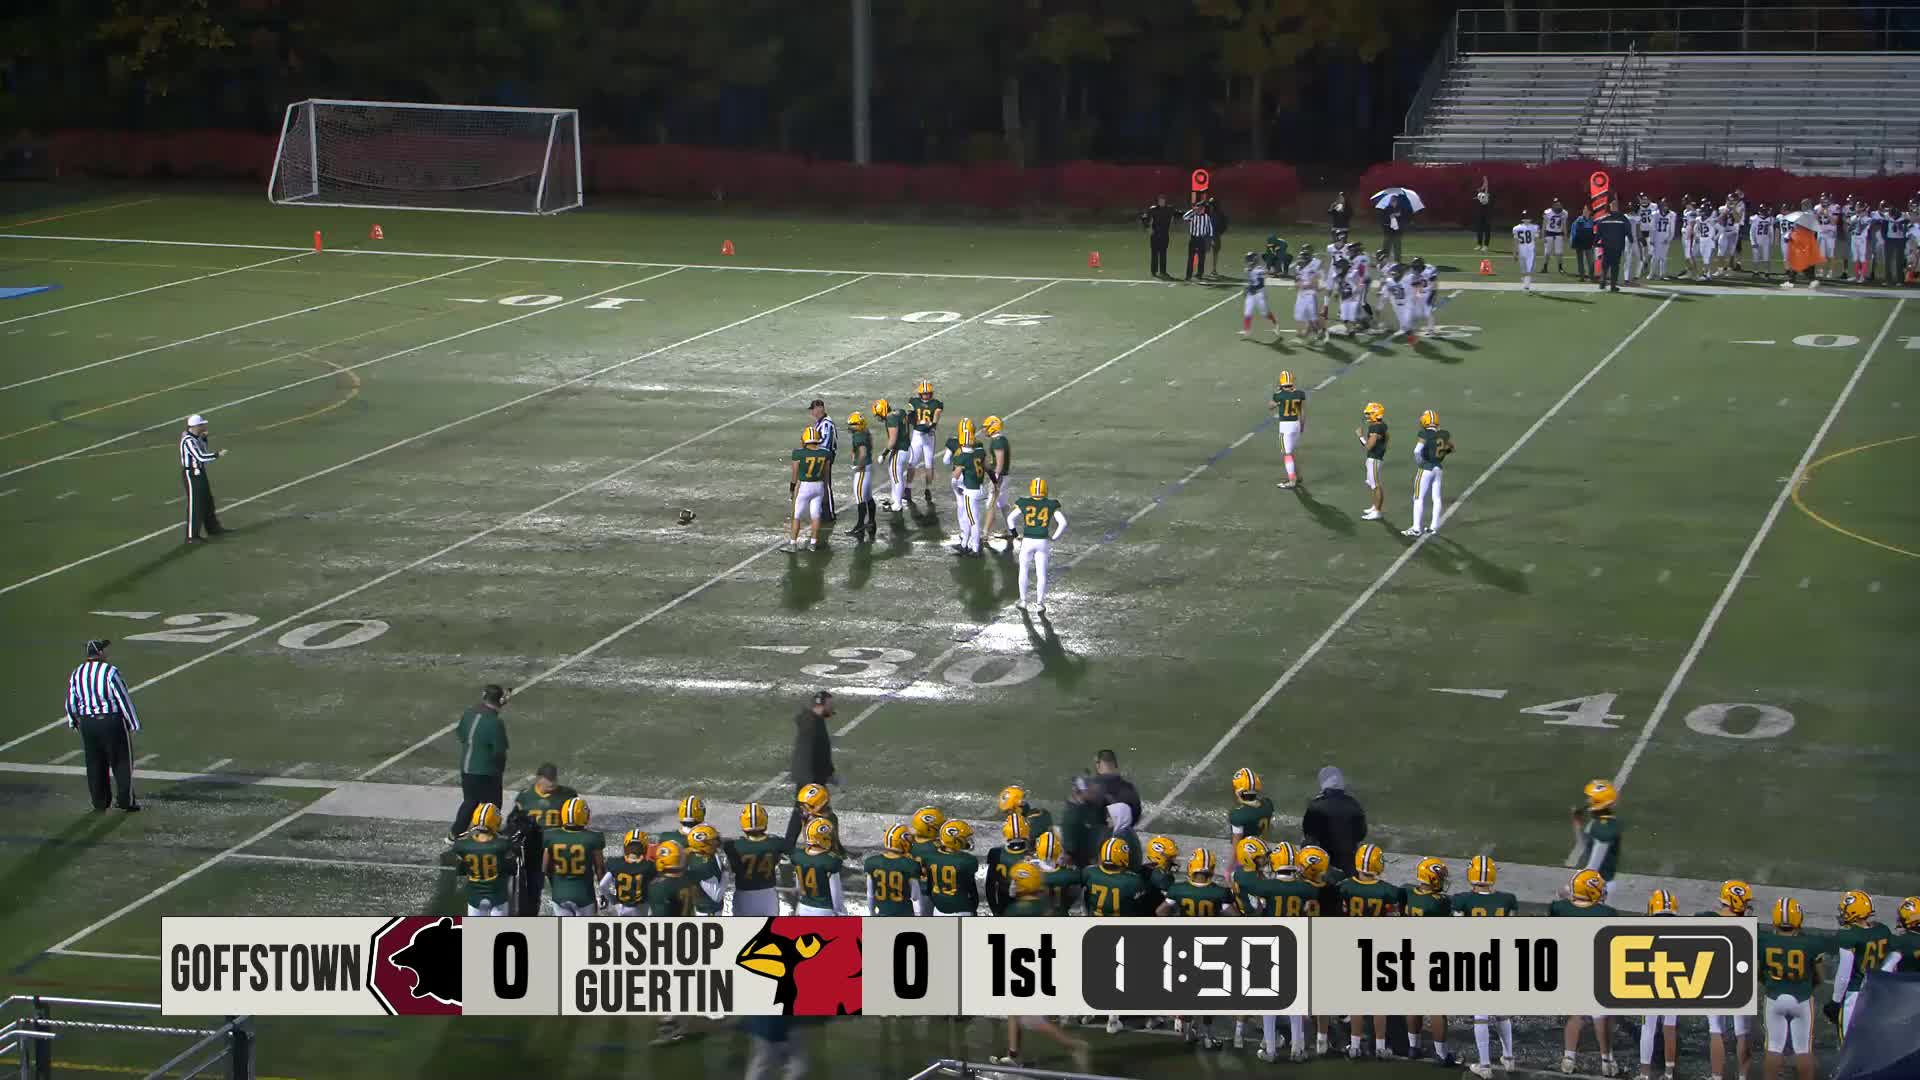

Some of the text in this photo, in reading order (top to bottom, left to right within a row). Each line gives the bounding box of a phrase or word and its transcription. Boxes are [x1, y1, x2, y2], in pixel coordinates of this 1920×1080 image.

[1518, 231, 1532, 245] 58
[916, 407, 931, 425] 16
[1283, 399, 1300, 417] 15
[804, 456, 827, 478] 77
[1025, 506, 1049, 527] 24
[122, 611, 392, 650] 20
[799, 647, 1044, 687] 30
[1519, 692, 1795, 738] 40
[464, 853, 498, 882] 38
[552, 843, 586, 874] 52
[742, 853, 774, 880] 74
[616, 872, 642, 901] 21
[872, 868, 904, 901] 39
[929, 864, 957, 895] 19
[1090, 884, 1121, 917] 71
[1765, 946, 1806, 981] 59
